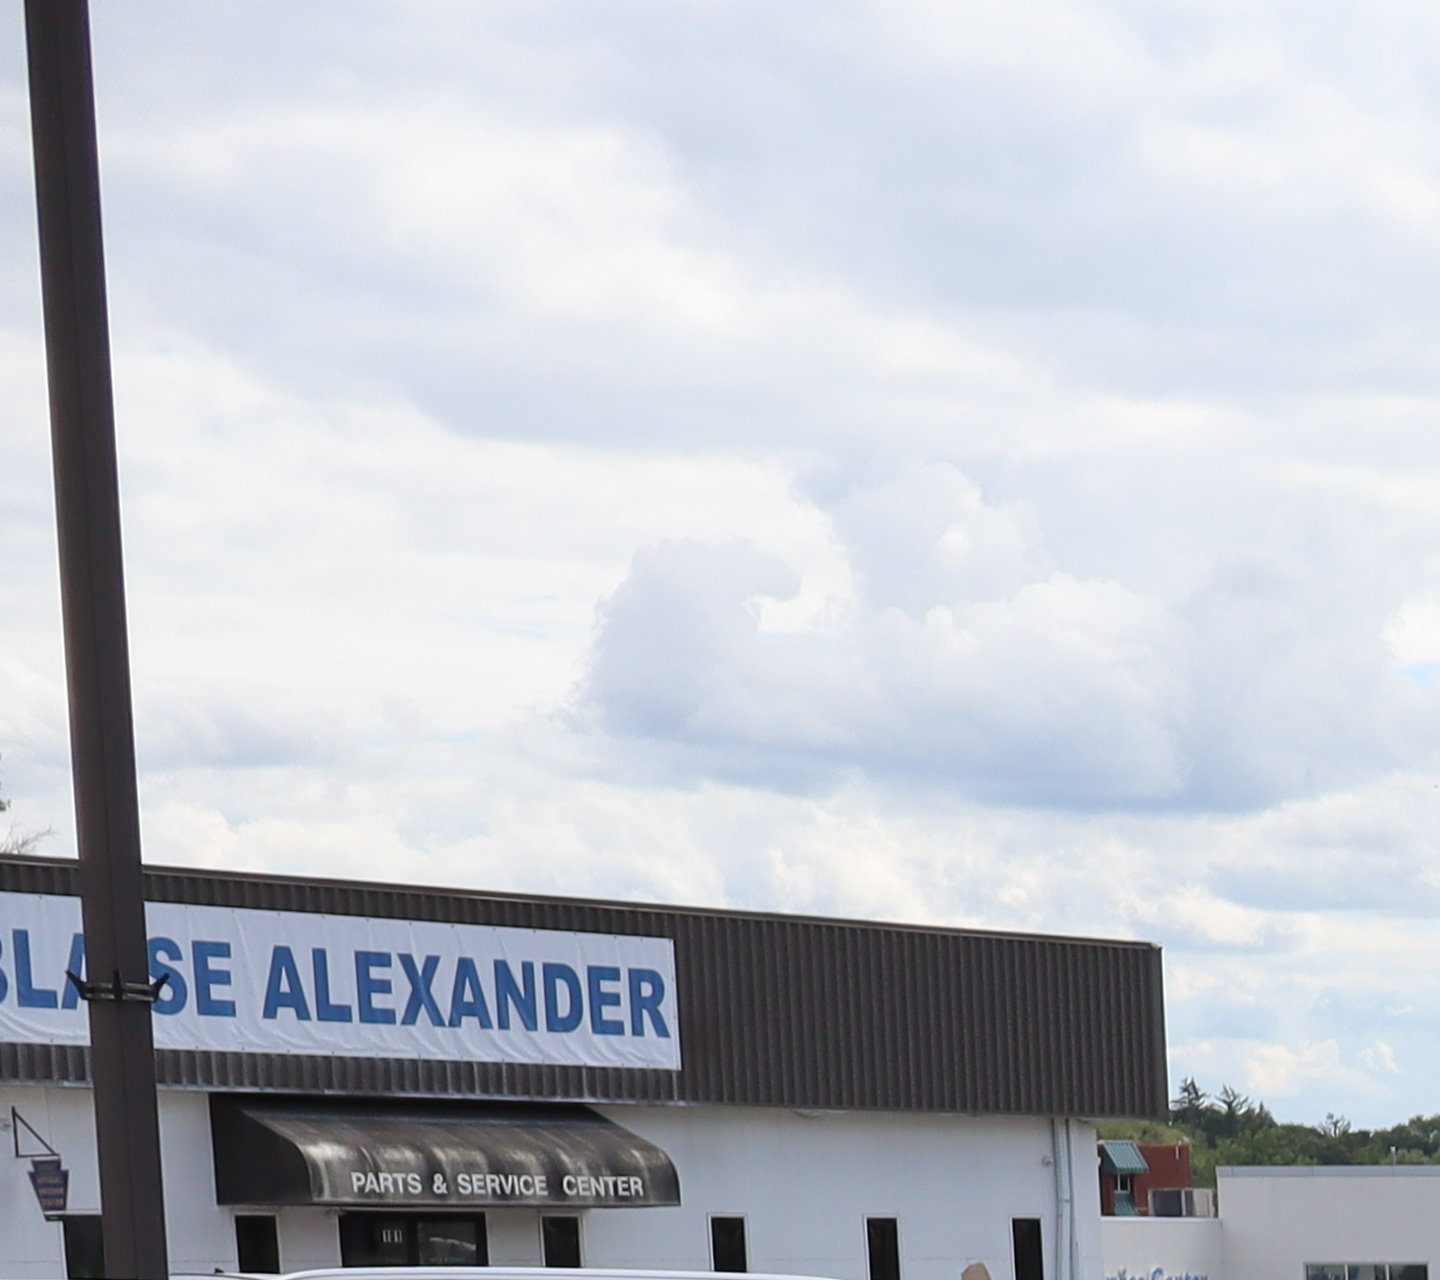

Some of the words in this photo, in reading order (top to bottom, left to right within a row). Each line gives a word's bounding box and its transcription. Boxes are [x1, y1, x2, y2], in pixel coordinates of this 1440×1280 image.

[262, 945, 671, 1038] ALEXANDER
[351, 1172, 422, 1194] PARTS
[433, 1175, 448, 1194] &
[458, 1174, 548, 1196] SERVICE
[563, 1175, 645, 1197] CENTER
